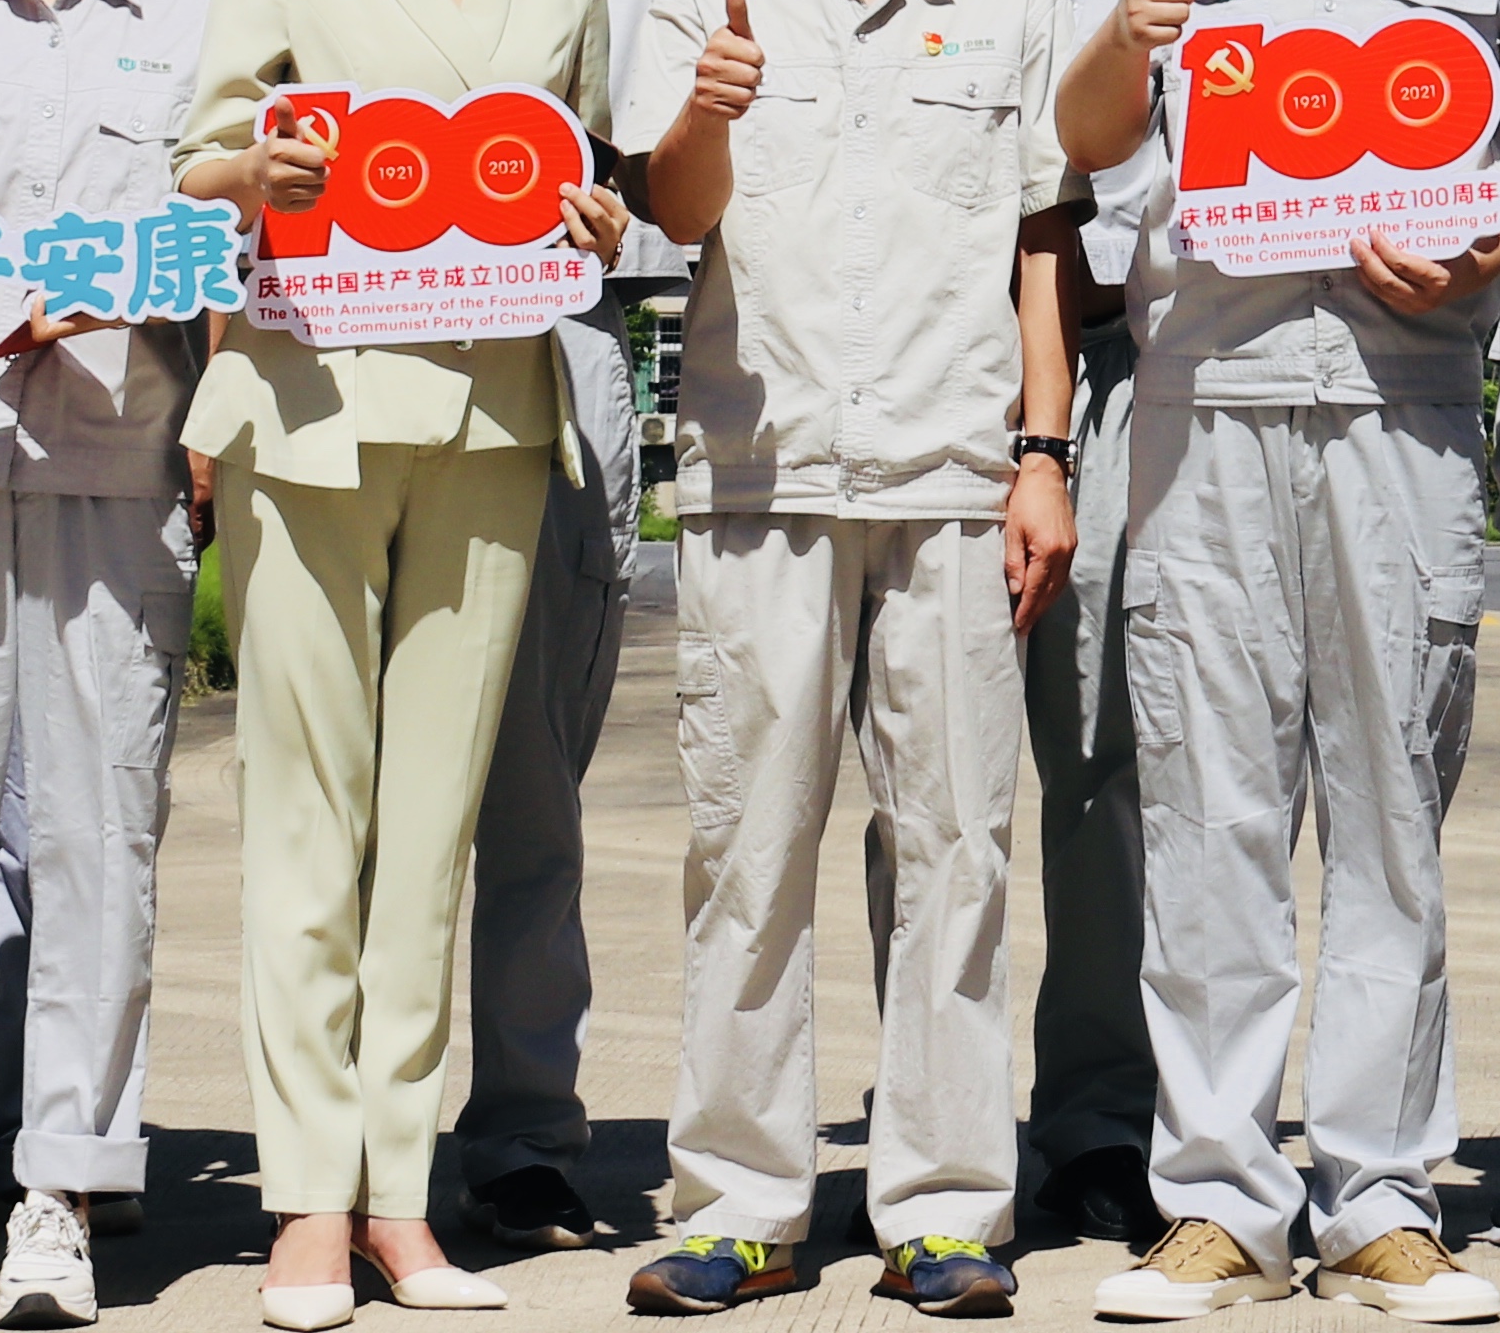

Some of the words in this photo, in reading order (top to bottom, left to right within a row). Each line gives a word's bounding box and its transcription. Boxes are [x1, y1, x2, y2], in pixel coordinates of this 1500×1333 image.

[1292, 93, 1328, 110] 1921
[1400, 84, 1437, 101] 2021
[378, 164, 415, 181] 1921
[487, 159, 525, 176] 2021
[1180, 181, 1499, 230] 庆祝中国共产党成立100周年
[1180, 237, 1208, 251] The
[1214, 234, 1255, 247] 100th
[1260, 225, 1351, 244] Anniversary
[1357, 222, 1371, 235] of
[1377, 221, 1400, 234] the
[1405, 215, 1478, 232] Founding
[1483, 212, 1498, 225] of
[1225, 253, 1253, 265] The
[1258, 245, 1346, 262] Communist
[1396, 237, 1410, 250] of
[1416, 235, 1460, 249] China
[258, 260, 586, 299] 庆祝中国共产党成立100周年
[258, 307, 287, 321] The
[293, 304, 335, 319] 100th
[340, 298, 435, 316] Anniversary
[440, 296, 455, 309] of
[460, 294, 484, 308] the
[490, 290, 564, 308] Founding
[569, 289, 584, 303] of
[304, 323, 332, 336] The
[338, 317, 428, 334] Communist
[433, 314, 473, 331] Party
[479, 314, 495, 326] of
[500, 310, 544, 325] China
